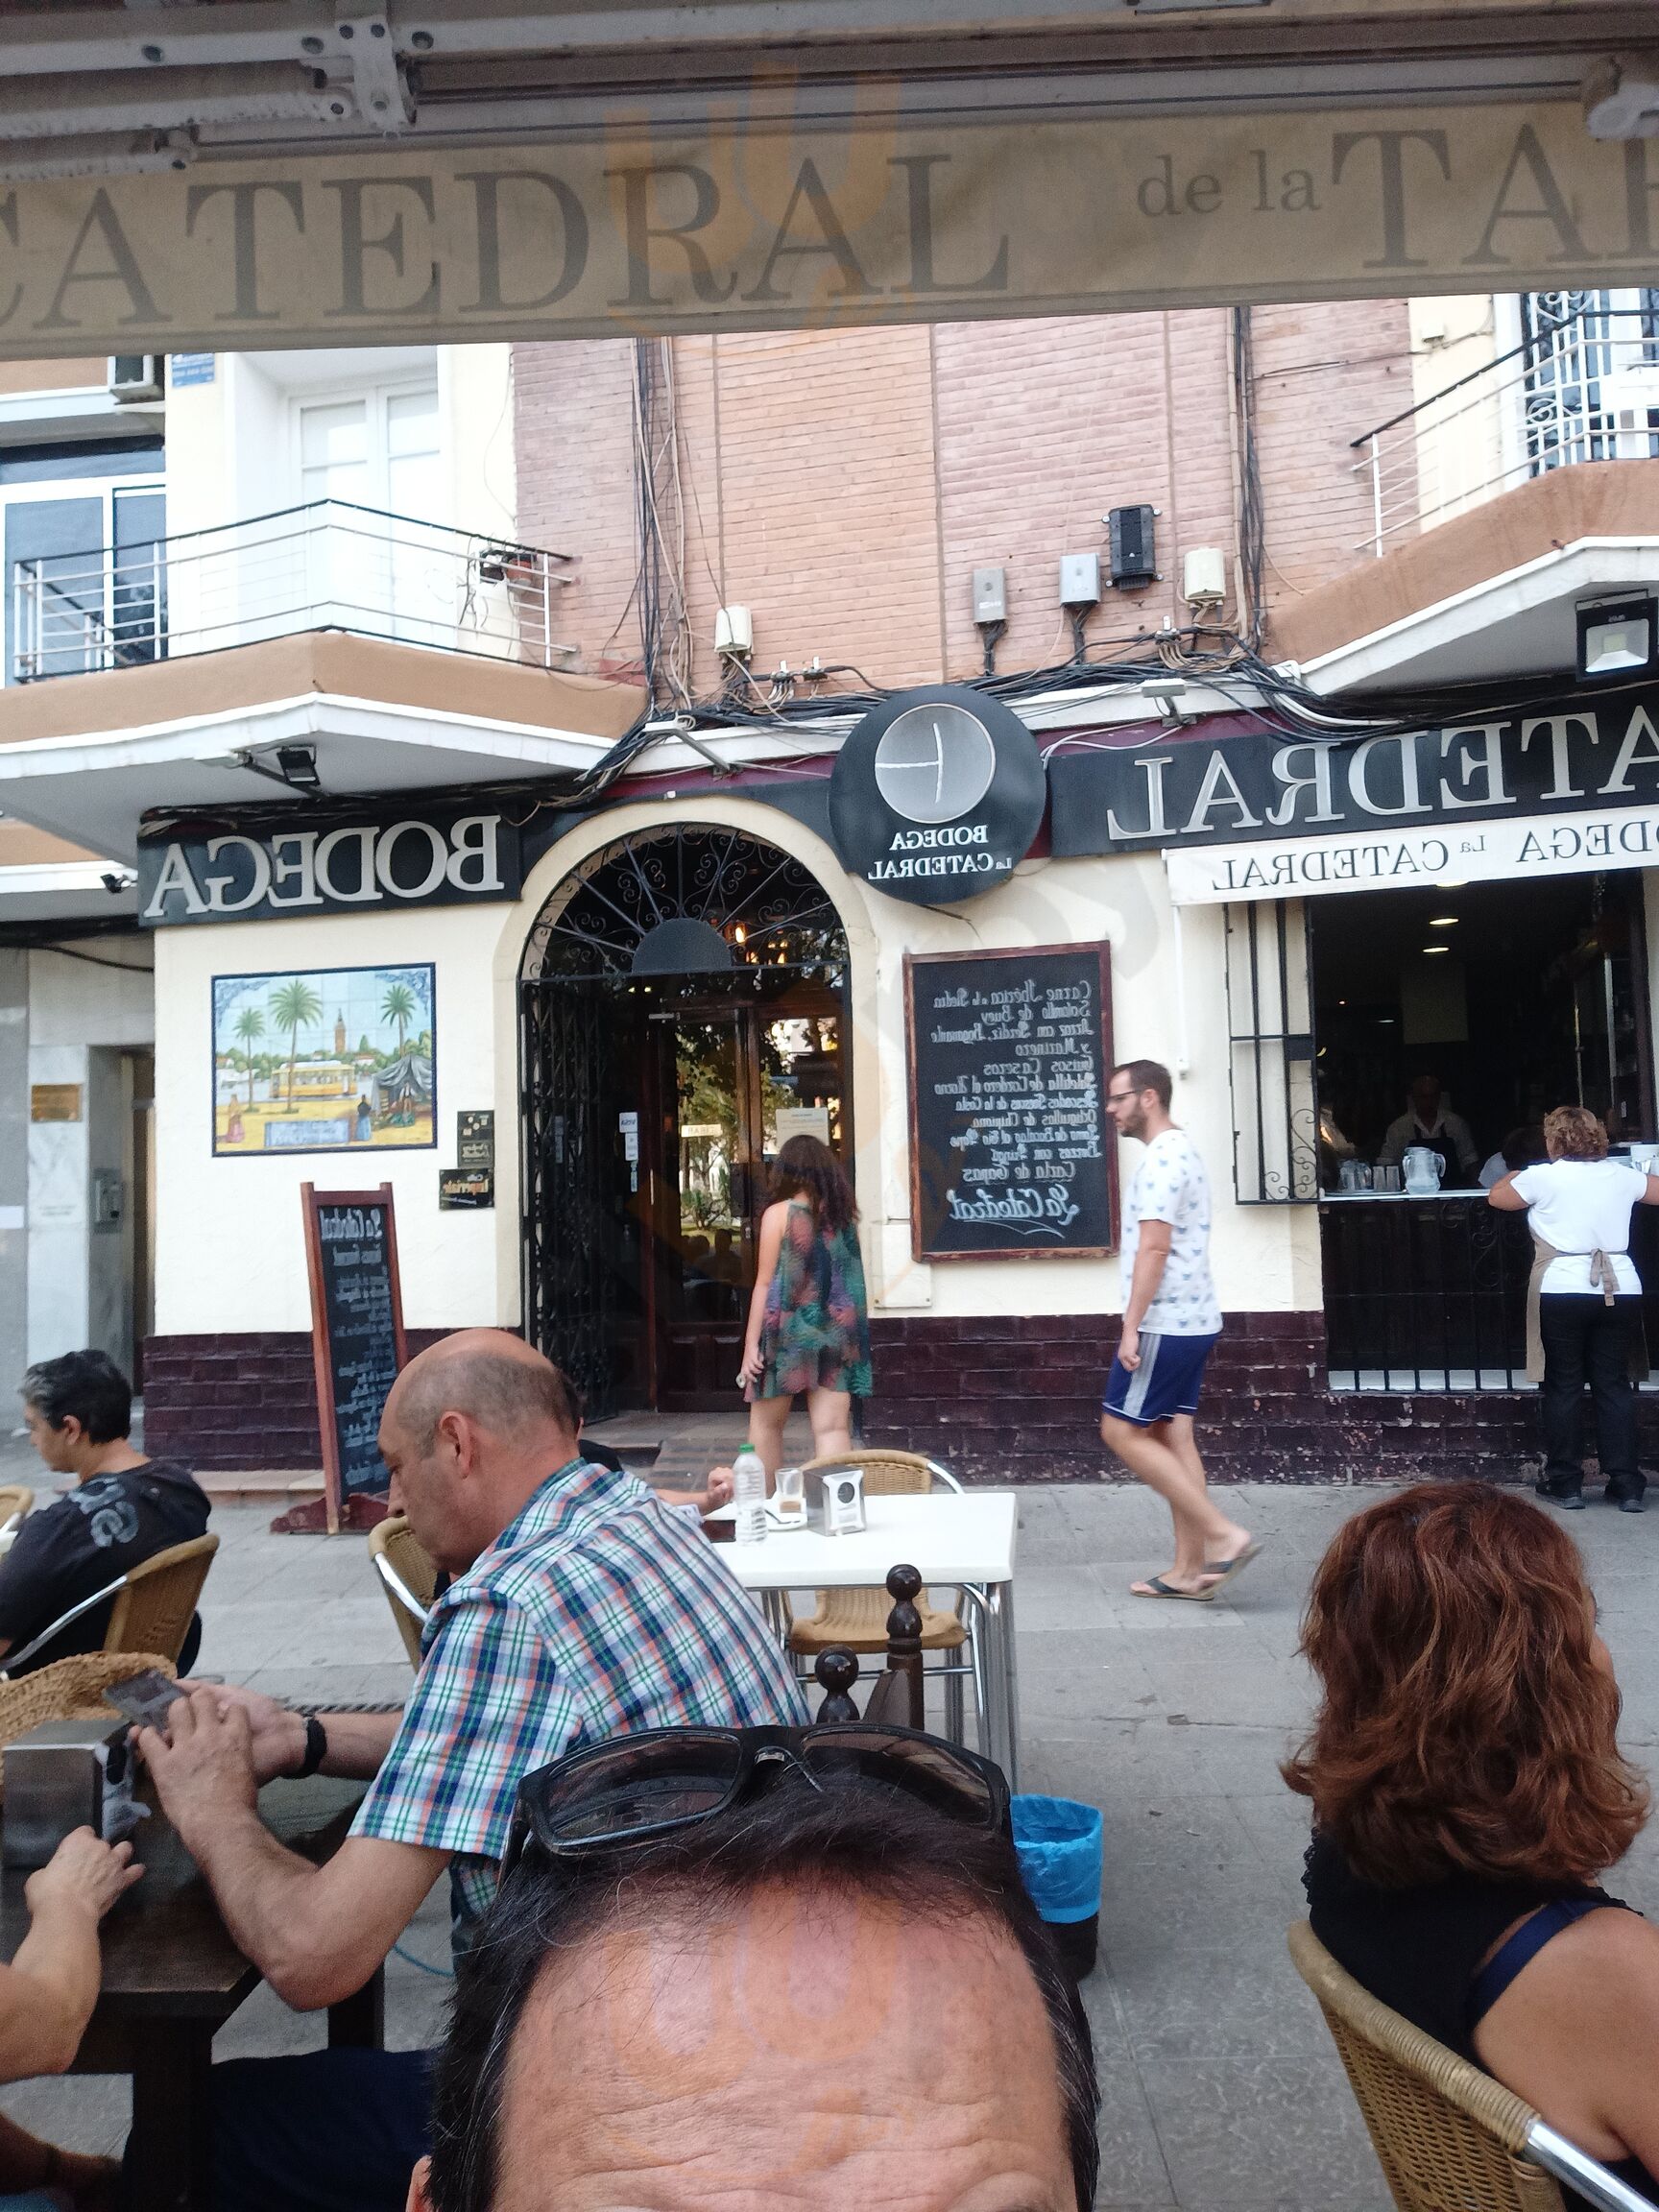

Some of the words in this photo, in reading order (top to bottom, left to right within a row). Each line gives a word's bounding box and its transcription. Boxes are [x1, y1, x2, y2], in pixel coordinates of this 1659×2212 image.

[0, 154, 1009, 329] ATEDRAL
[1136, 154, 1223, 217] de
[1249, 150, 1321, 213] la
